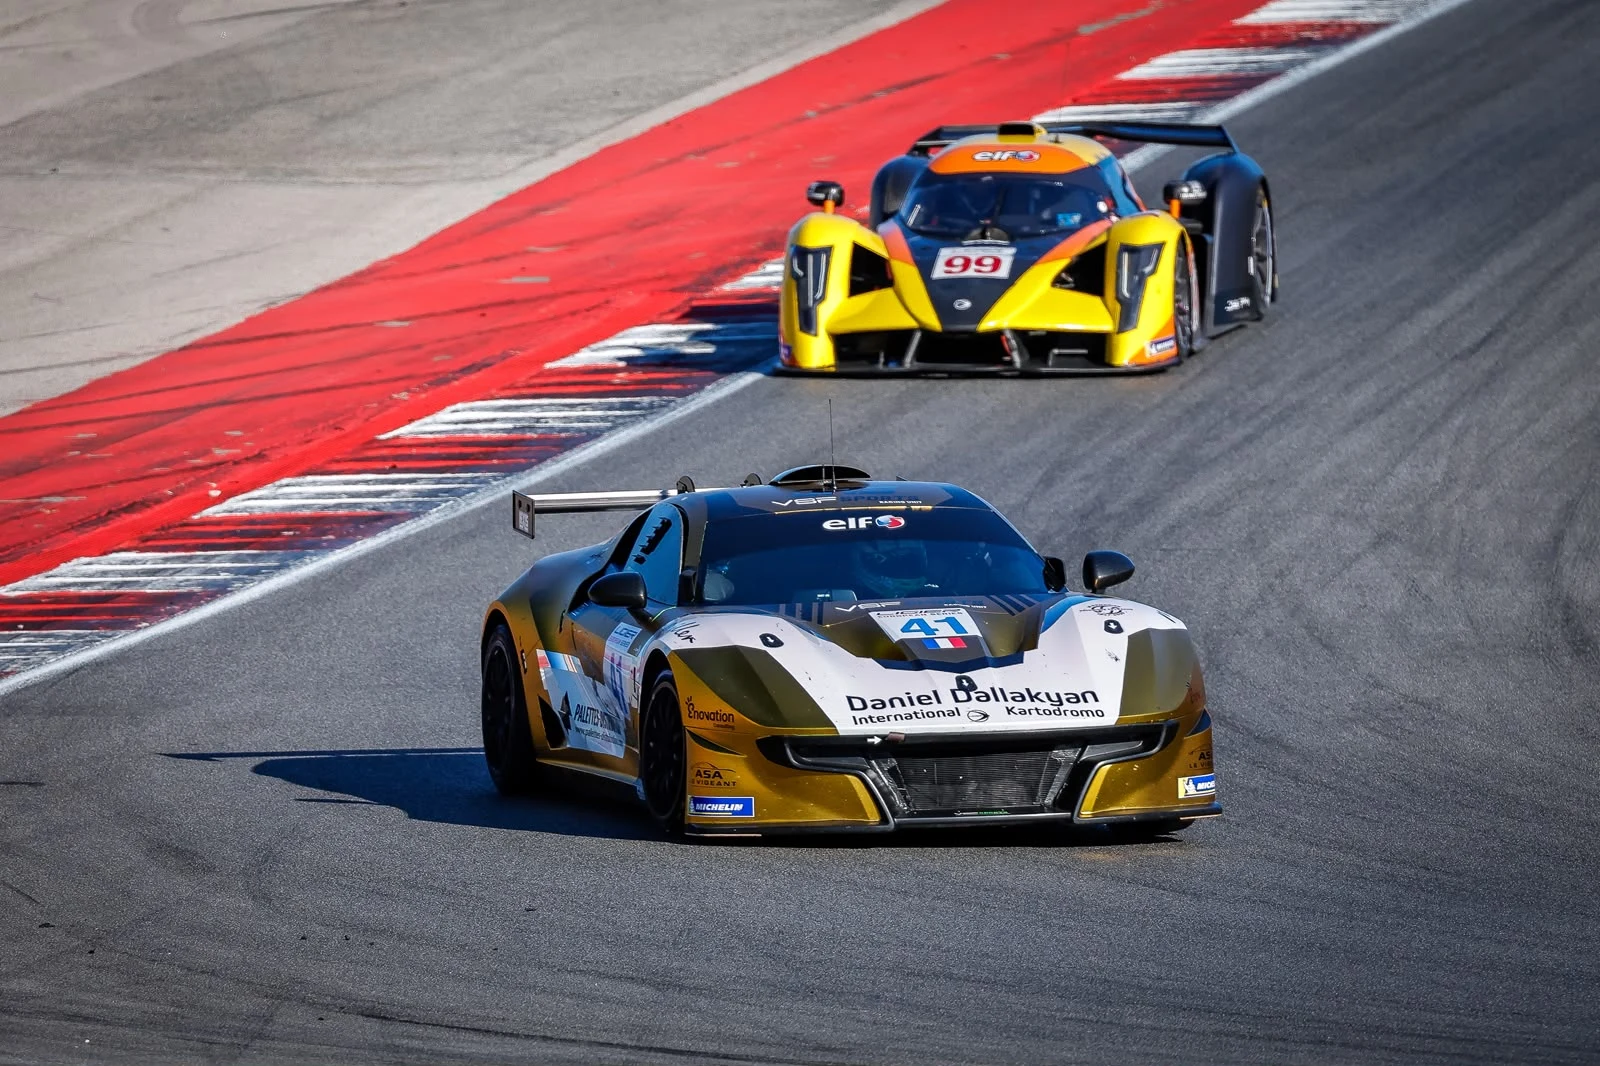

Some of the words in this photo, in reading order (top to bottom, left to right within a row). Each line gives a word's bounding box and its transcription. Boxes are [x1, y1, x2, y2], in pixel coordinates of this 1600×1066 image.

[973, 151, 1018, 161] elf
[944, 255, 1003, 275] 99
[822, 516, 873, 530] elf
[900, 616, 968, 636] 41
[845, 689, 943, 712] Daniel
[949, 686, 1100, 707] Dallakyan
[852, 706, 961, 725] International
[1005, 706, 1105, 718] Kartodromo
[695, 769, 723, 780] ASA
[695, 803, 744, 811] MICHELIN
